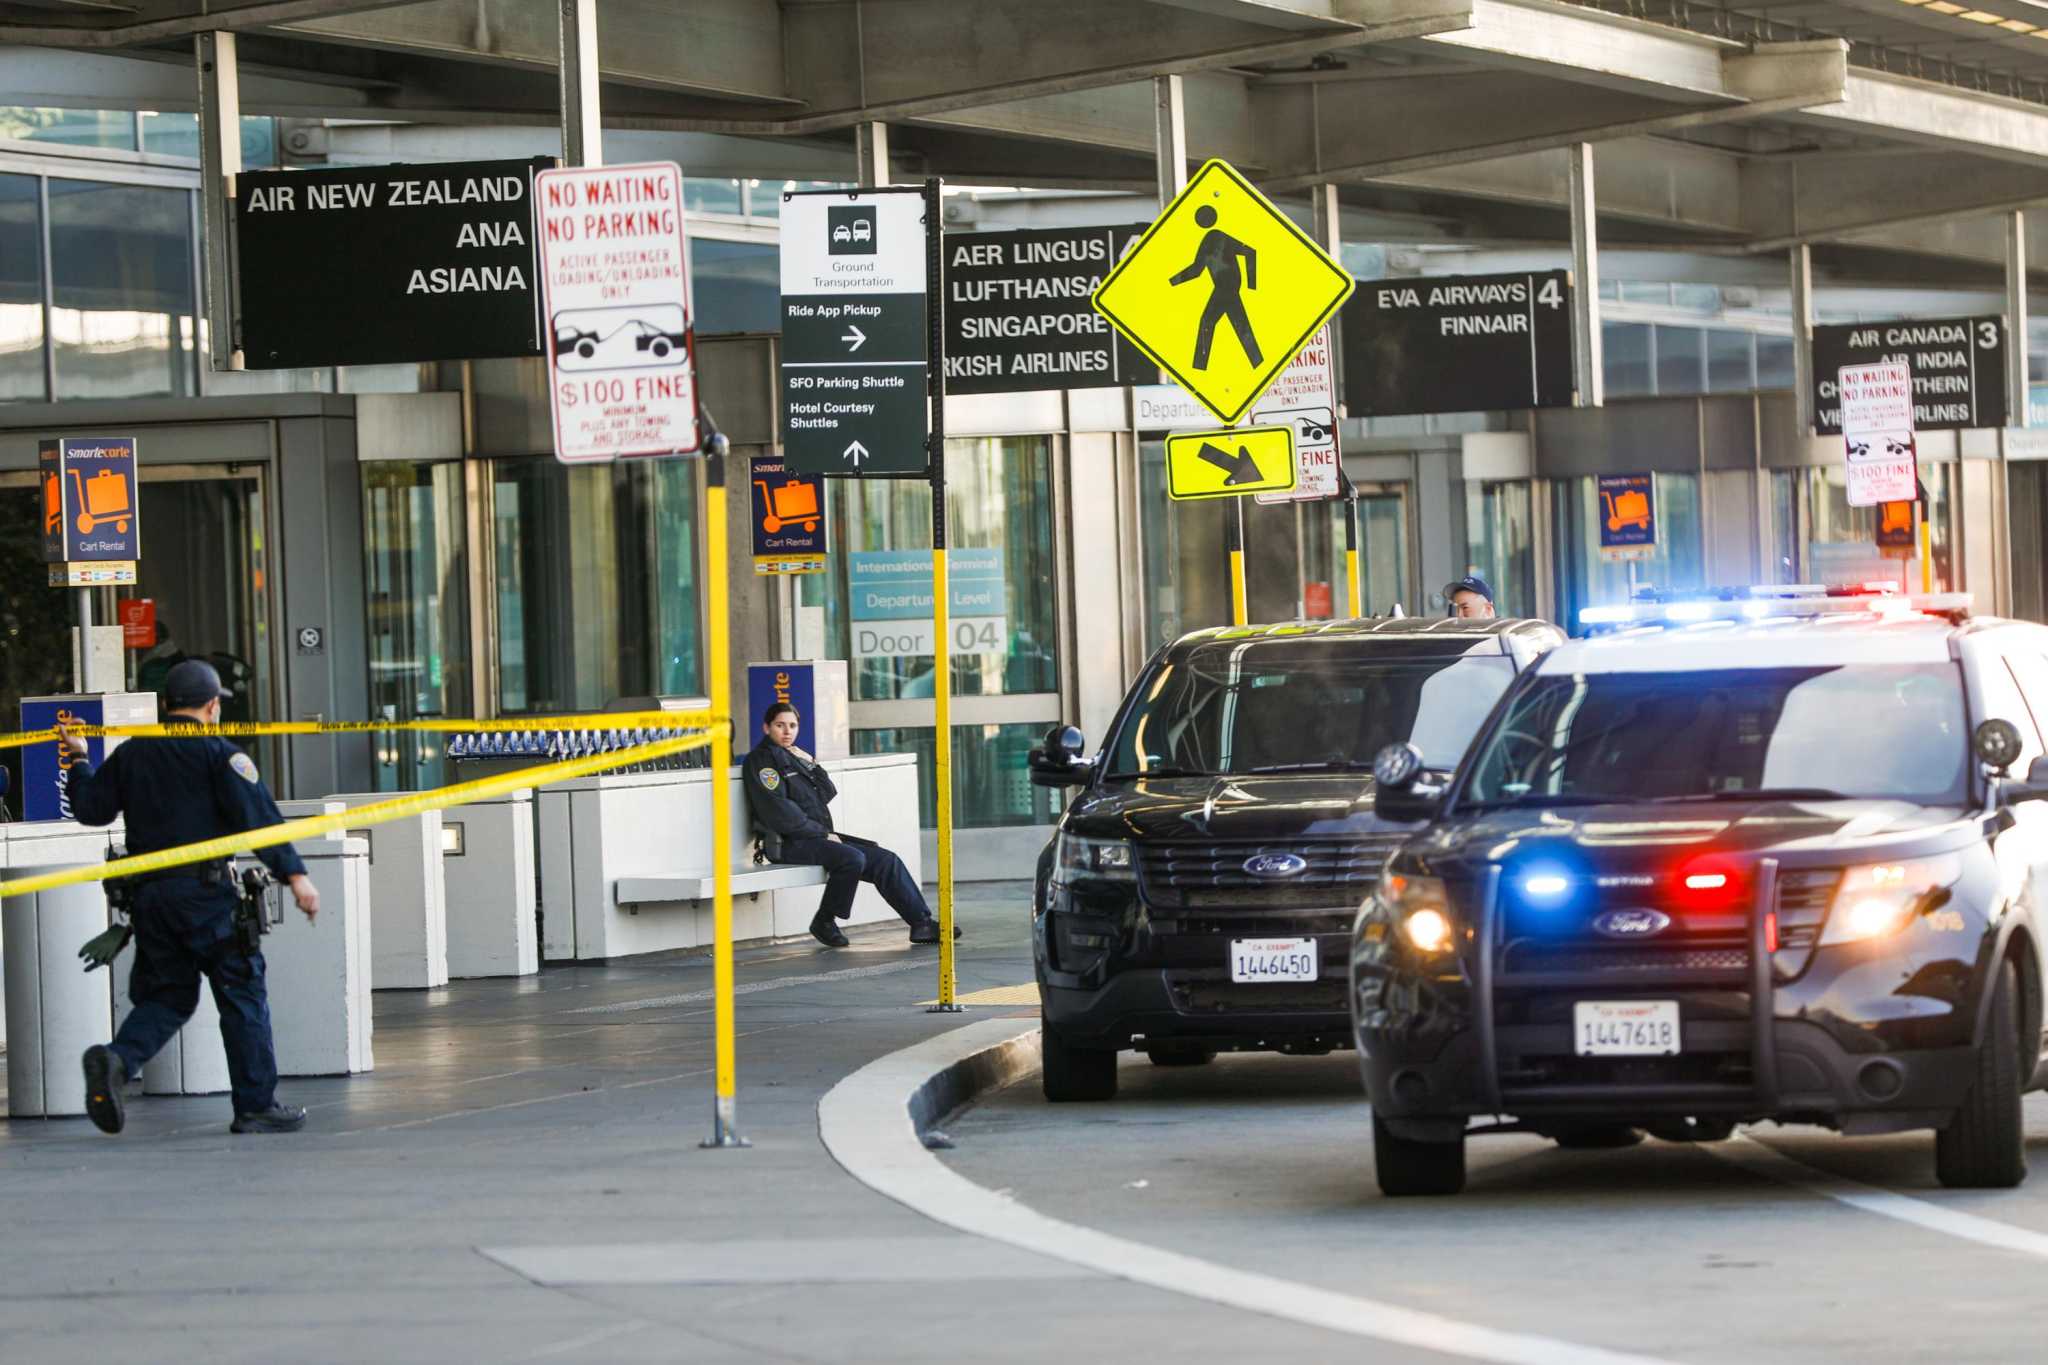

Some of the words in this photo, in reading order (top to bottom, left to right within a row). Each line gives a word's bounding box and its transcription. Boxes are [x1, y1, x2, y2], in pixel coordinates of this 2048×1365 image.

[247, 186, 296, 213] AIR
[307, 183, 376, 210] NEW
[388, 176, 523, 207] ZEALAND
[548, 182, 577, 208] NO
[585, 175, 670, 206] WAITING
[455, 221, 526, 248] ANA
[547, 216, 575, 242] NO
[584, 209, 674, 239] PARKING
[560, 254, 598, 269] ACTIVE
[604, 249, 670, 265] PASSENGER
[952, 244, 1004, 267] AER
[1013, 239, 1105, 264] LINGUS
[832, 261, 875, 273] Ground
[406, 265, 527, 295] ASIANA
[813, 276, 894, 289] Transportation
[601, 285, 631, 299] ONLY
[1378, 288, 1421, 309] EVA
[1428, 283, 1526, 306] AIRWAYS
[1537, 279, 1564, 309] 4
[788, 305, 814, 317] Ride
[816, 305, 841, 318] App
[843, 304, 882, 318] Pickup
[961, 313, 1108, 339] SINGAPORE
[1440, 314, 1528, 336] FINNAIR
[1848, 330, 1880, 349] AIR
[1885, 326, 1967, 346] CANADA
[1978, 322, 1998, 349] 3
[944, 354, 1003, 377] RKISH
[1010, 350, 1109, 375] AIRLINES
[1916, 351, 1967, 370] INDIA
[789, 377, 814, 389] SFO
[816, 377, 859, 390] Parking
[862, 376, 905, 388] Shuttle
[1845, 374, 1859, 385] NO
[1863, 370, 1904, 383] WAITING
[1912, 375, 1969, 394] THERN
[560, 378, 624, 408] $100
[635, 374, 687, 400] FINE
[1844, 390, 1858, 401] NO
[1862, 385, 1906, 399] PARKING
[790, 402, 821, 414] Hotel
[823, 402, 875, 415] Courtesy
[1914, 403, 1969, 422] RLINES
[790, 417, 839, 429] Shuttles
[1301, 450, 1334, 466] FINE
[80, 541, 98, 552] Cart
[99, 540, 125, 551] Rental
[765, 538, 784, 548] Cart
[786, 537, 813, 547] Rental
[950, 558, 997, 570] erminal
[954, 591, 992, 605] Level
[859, 630, 924, 653] Door
[955, 622, 999, 650] 04
[1256, 856, 1292, 872] Ford
[1609, 912, 1652, 933] Ford
[1238, 954, 1312, 976] 1446450
[1585, 1021, 1673, 1047] 1447618
